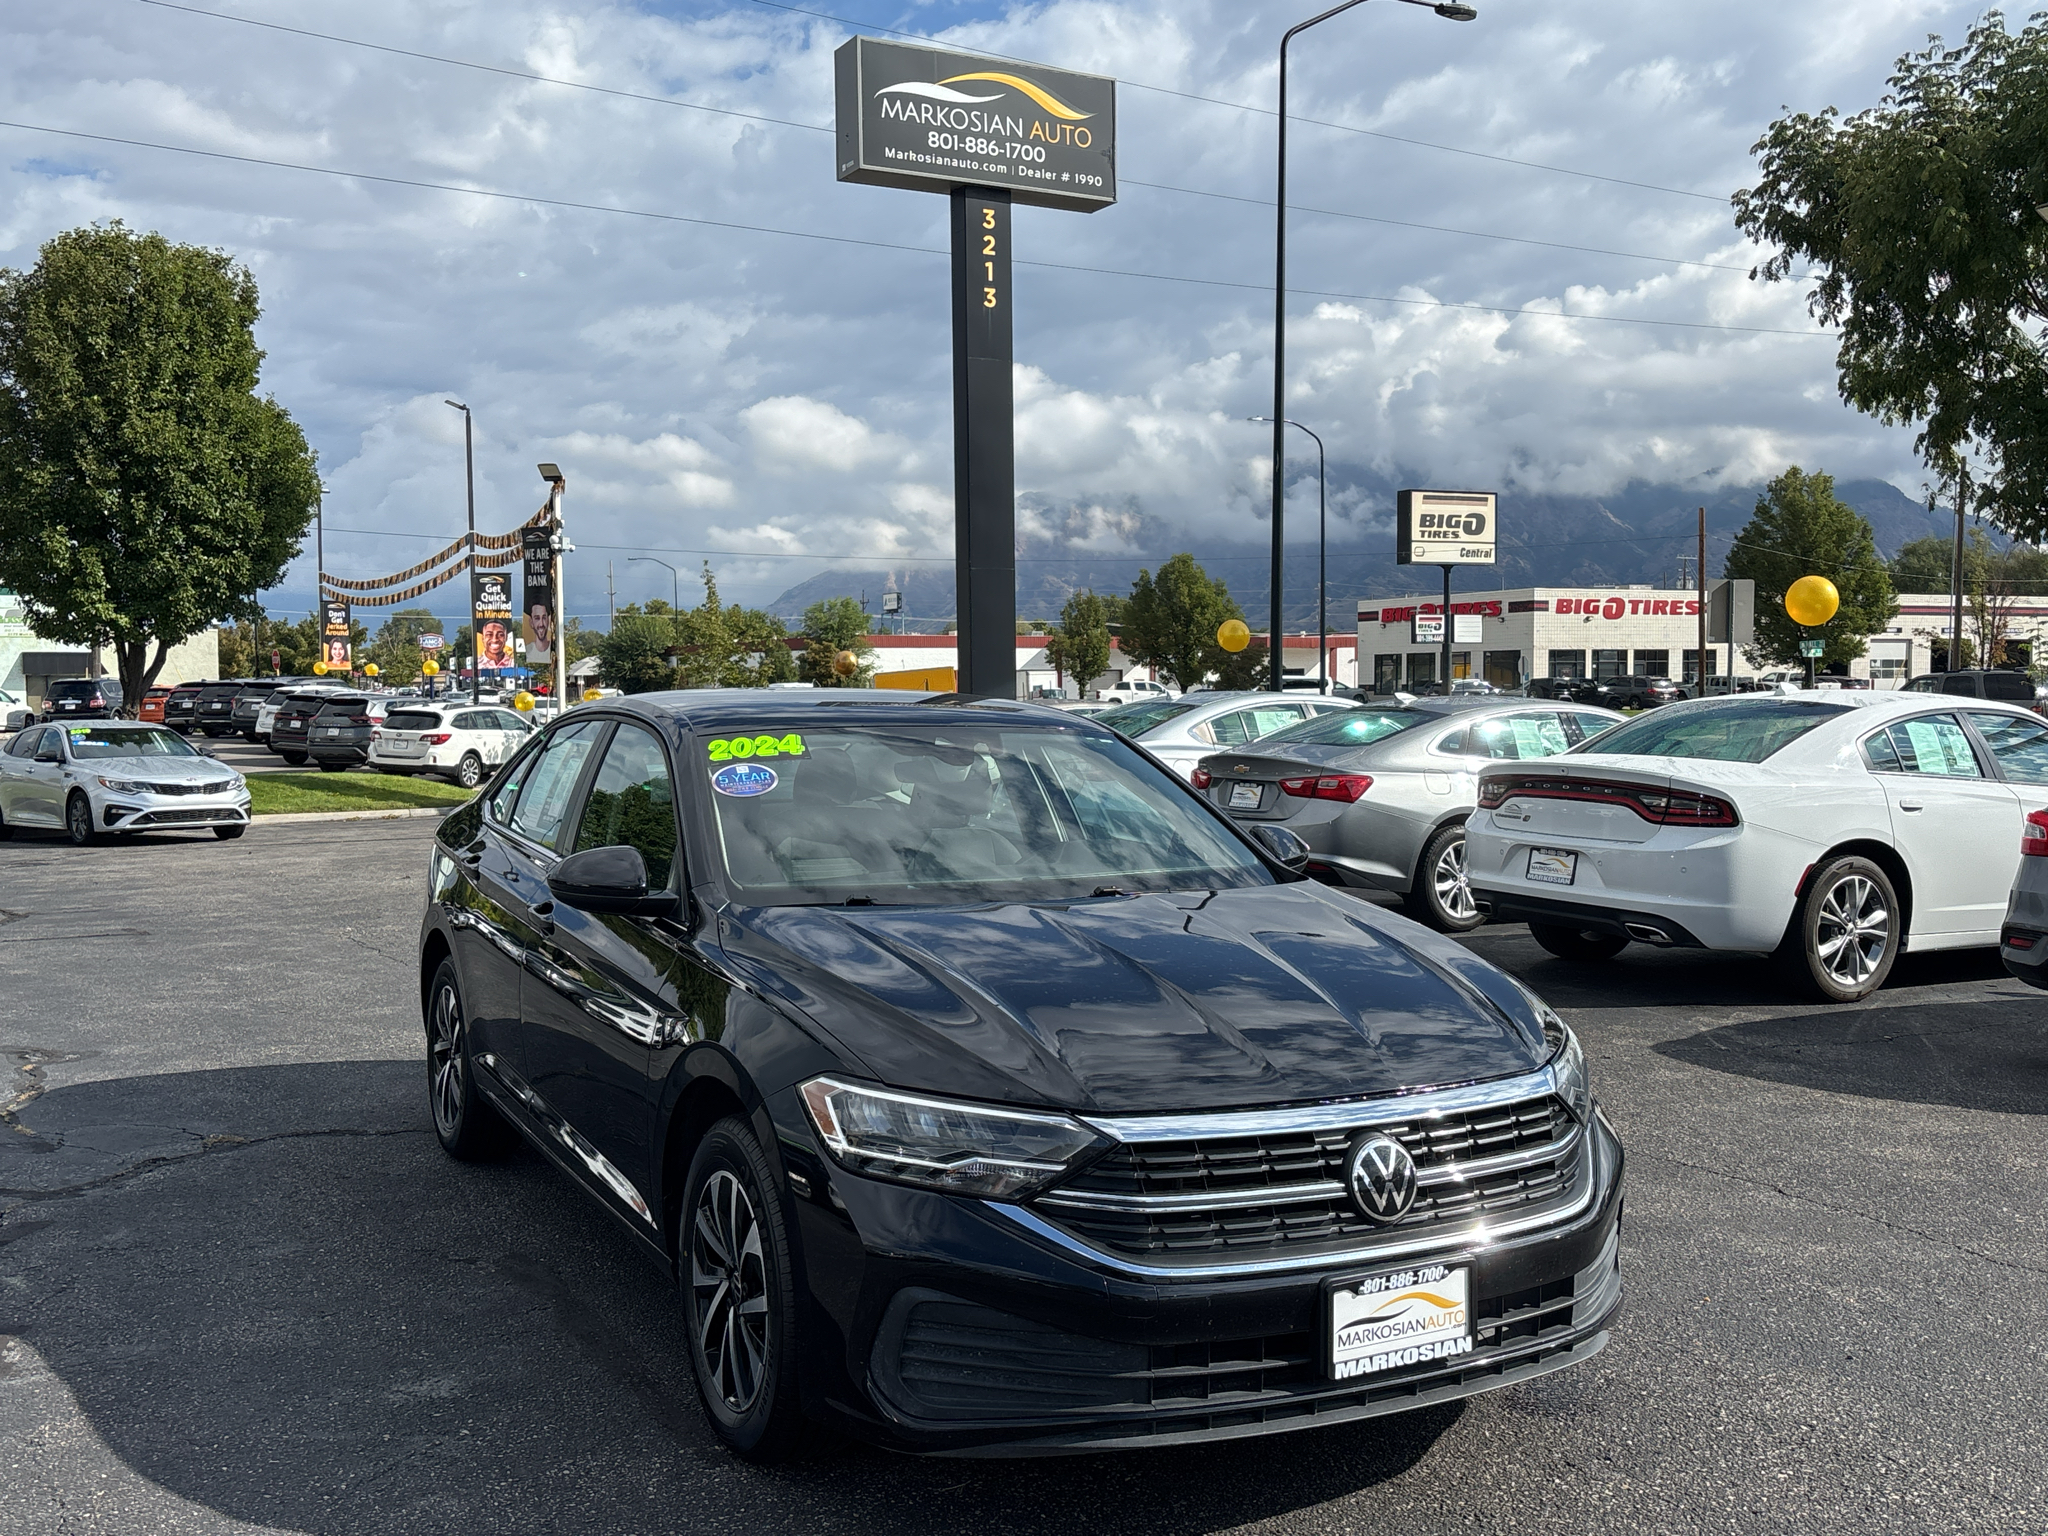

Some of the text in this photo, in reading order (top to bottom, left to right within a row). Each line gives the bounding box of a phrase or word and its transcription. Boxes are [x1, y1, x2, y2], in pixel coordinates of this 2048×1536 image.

[881, 97, 1092, 148] MARKOSIAN AUTO
[927, 131, 1046, 163] 801-886-1700
[884, 146, 1103, 187] Markosianauto.com Dealer # 1990
[1419, 513, 1462, 529] BIG
[1419, 529, 1460, 539] TIRES
[524, 547, 550, 561] WE ARE
[1460, 547, 1493, 558] Central
[529, 561, 545, 574] THE
[527, 574, 548, 587] BANK
[485, 583, 501, 593] Get
[480, 592, 507, 603] Quick
[475, 600, 512, 611] Qualified
[1555, 598, 1601, 615] BIG
[1627, 599, 1699, 615] TIRES
[328, 610, 346, 618] Don't
[475, 610, 512, 619] In Minutes
[330, 617, 344, 625] Get
[325, 629, 350, 637] Around
[708, 733, 806, 761] 2024
[718, 771, 771, 784] 5 YEAR
[1363, 1265, 1444, 1294] 801-886-1700
[1334, 1336, 1473, 1380] MARKOSIAN
